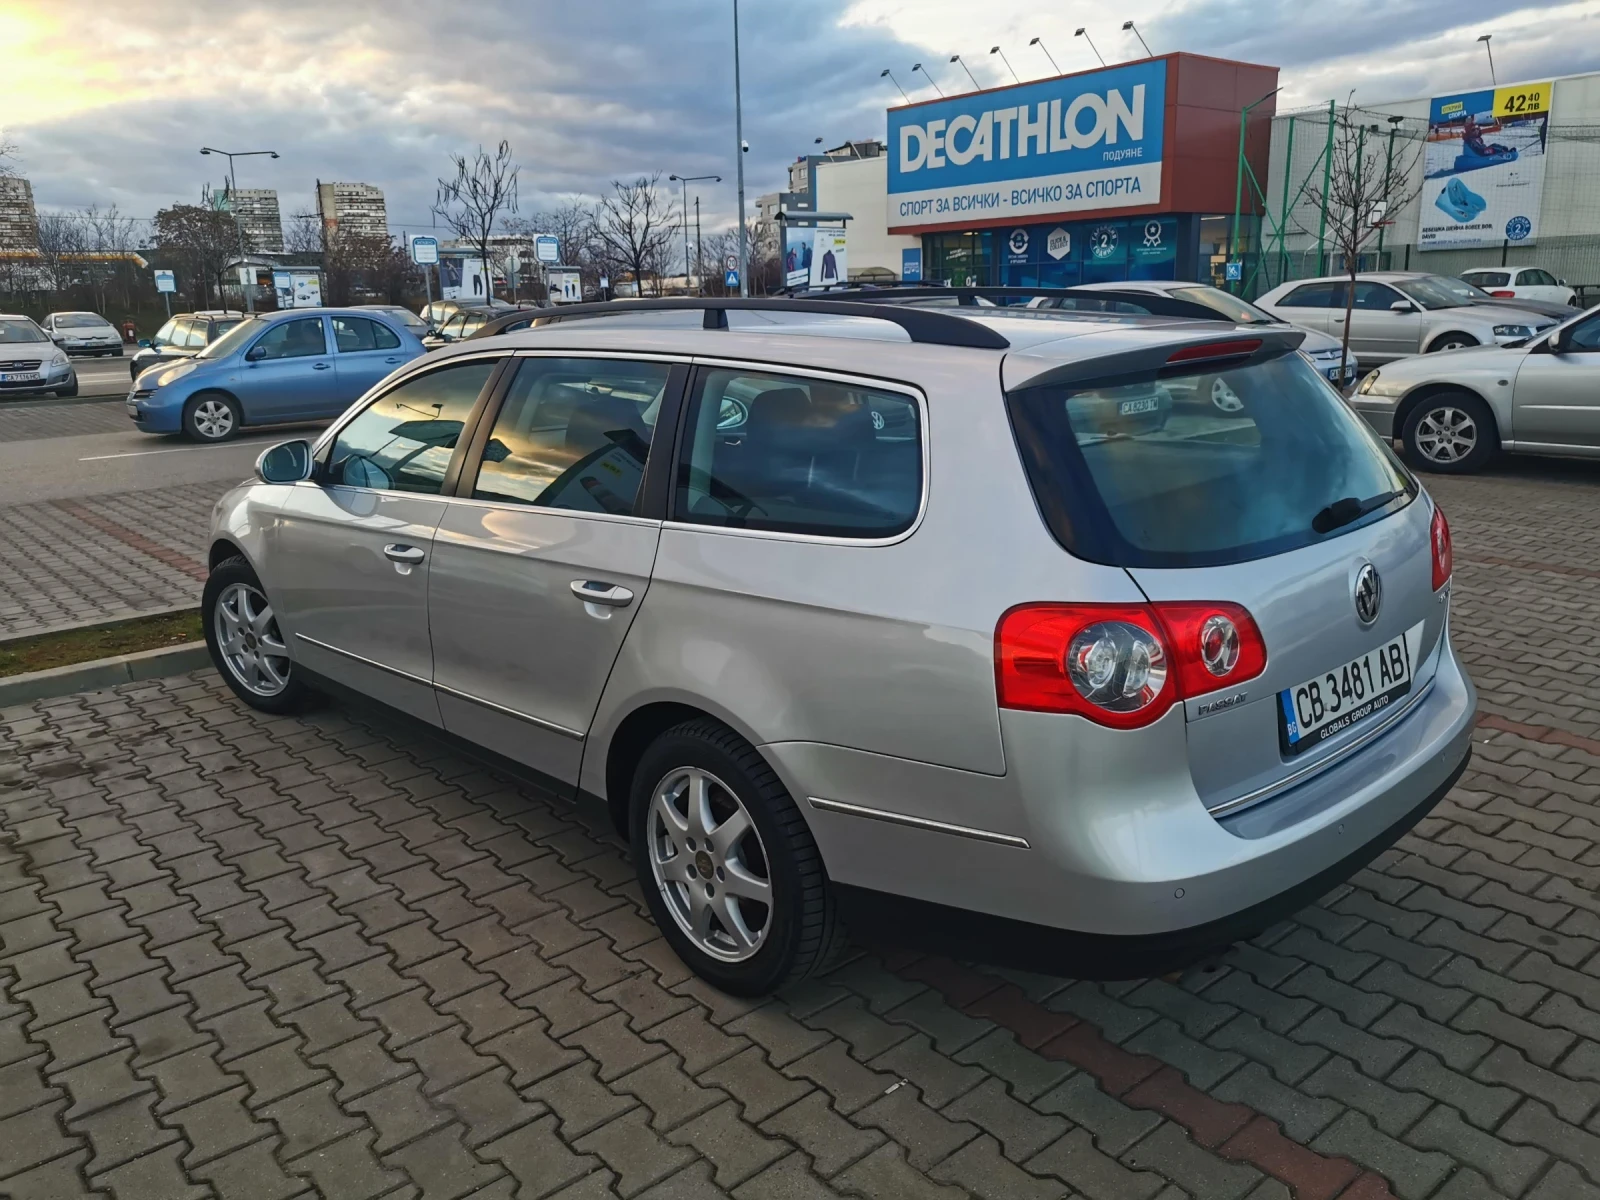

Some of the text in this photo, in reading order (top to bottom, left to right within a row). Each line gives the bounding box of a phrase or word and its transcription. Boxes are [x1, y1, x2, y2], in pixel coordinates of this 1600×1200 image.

[1504, 92, 1540, 112] 42 40
[900, 84, 1145, 173] DECATHLON
[1103, 147, 1143, 162] ПОДУЯНЕ
[900, 200, 934, 217] СПОРТ
[936, 198, 950, 213] ЗА
[953, 193, 1000, 212] ВСИЧКИ
[1011, 185, 1062, 206] ВСИЧКО
[1065, 183, 1082, 200] ЗА
[1086, 176, 1141, 198] СПОРТА
[1515, 223, 1521, 233] 2
[1101, 234, 1107, 248] 2
[1296, 643, 1405, 729] CB 3481 AB
[1198, 691, 1248, 715] PASSAT
[1320, 695, 1389, 739] GLOBALS GROUP AUTO
[1287, 721, 1297, 736] BG
